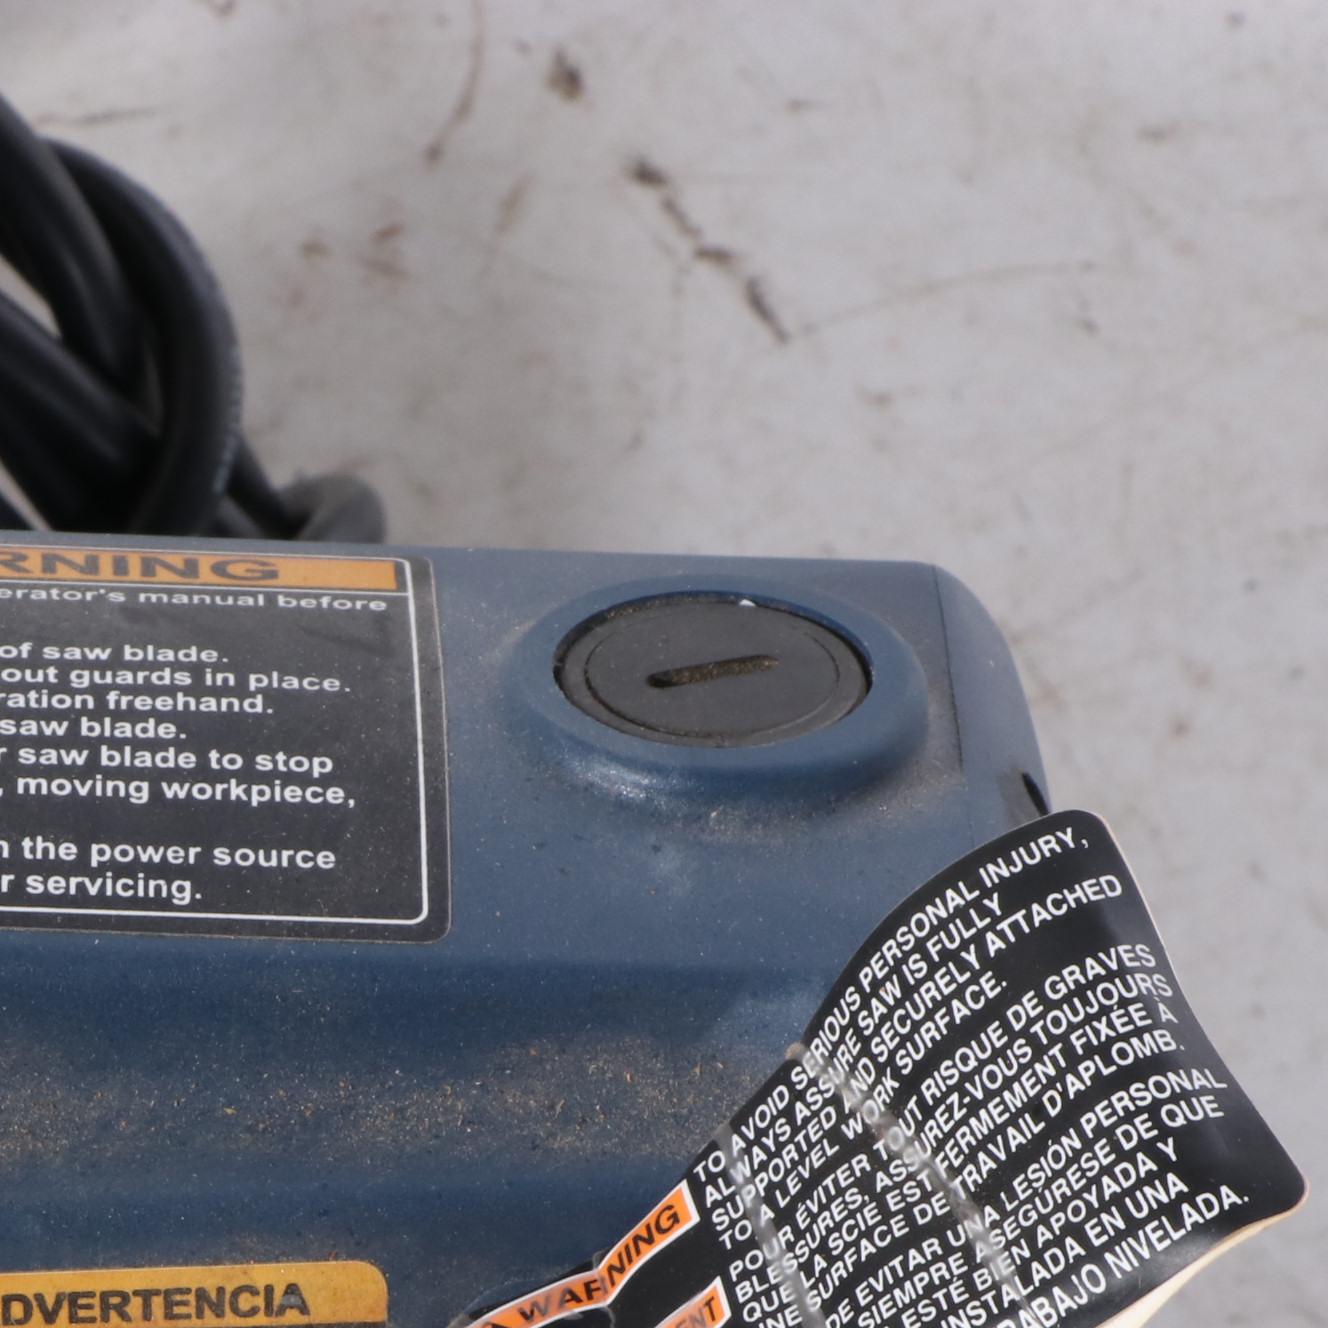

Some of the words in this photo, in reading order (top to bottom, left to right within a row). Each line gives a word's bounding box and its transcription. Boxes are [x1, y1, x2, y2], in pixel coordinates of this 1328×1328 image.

[138, 588, 264, 607] manual
[277, 593, 387, 611] before
[42, 644, 111, 659] saw
[123, 643, 228, 663] blade.
[69, 665, 192, 691] guards
[205, 669, 235, 688] in
[248, 671, 350, 696] place.
[105, 690, 273, 714] freehand.
[80, 716, 186, 740] blade.
[18, 747, 89, 765] saw
[100, 744, 196, 769] blade
[208, 750, 243, 771] to
[254, 751, 333, 778] stop
[16, 772, 149, 803] moving
[160, 777, 355, 811] workpiece,
[21, 835, 77, 861] the
[90, 842, 202, 871] power
[212, 847, 336, 870] source
[25, 868, 201, 906] servicing.
[693, 1151, 726, 1182] TO
[731, 1084, 790, 1157] AVOID
[791, 986, 860, 1090] SERIOUS
[859, 881, 980, 993] PERSONAL
[979, 827, 1088, 888] INJURY,
[705, 1117, 792, 1207] ALWAYS
[795, 1028, 861, 1125] ASSURE
[858, 974, 901, 1035] SAW
[902, 953, 927, 985] IS
[926, 892, 1002, 962] FULLY
[712, 1106, 836, 1230] SUPPORTED
[843, 1057, 876, 1113] AND
[871, 944, 980, 1062] SECURELY
[985, 875, 1122, 957] ATTACHED
[719, 1220, 752, 1250] TO
[759, 1203, 775, 1228] A
[775, 1138, 839, 1208] LEVEL
[841, 1067, 900, 1140] WORK
[895, 971, 1007, 1075] SURFACE.
[1104, 1185, 1249, 1279] NIVELADA.
[518, 1204, 680, 1323] WARNING
